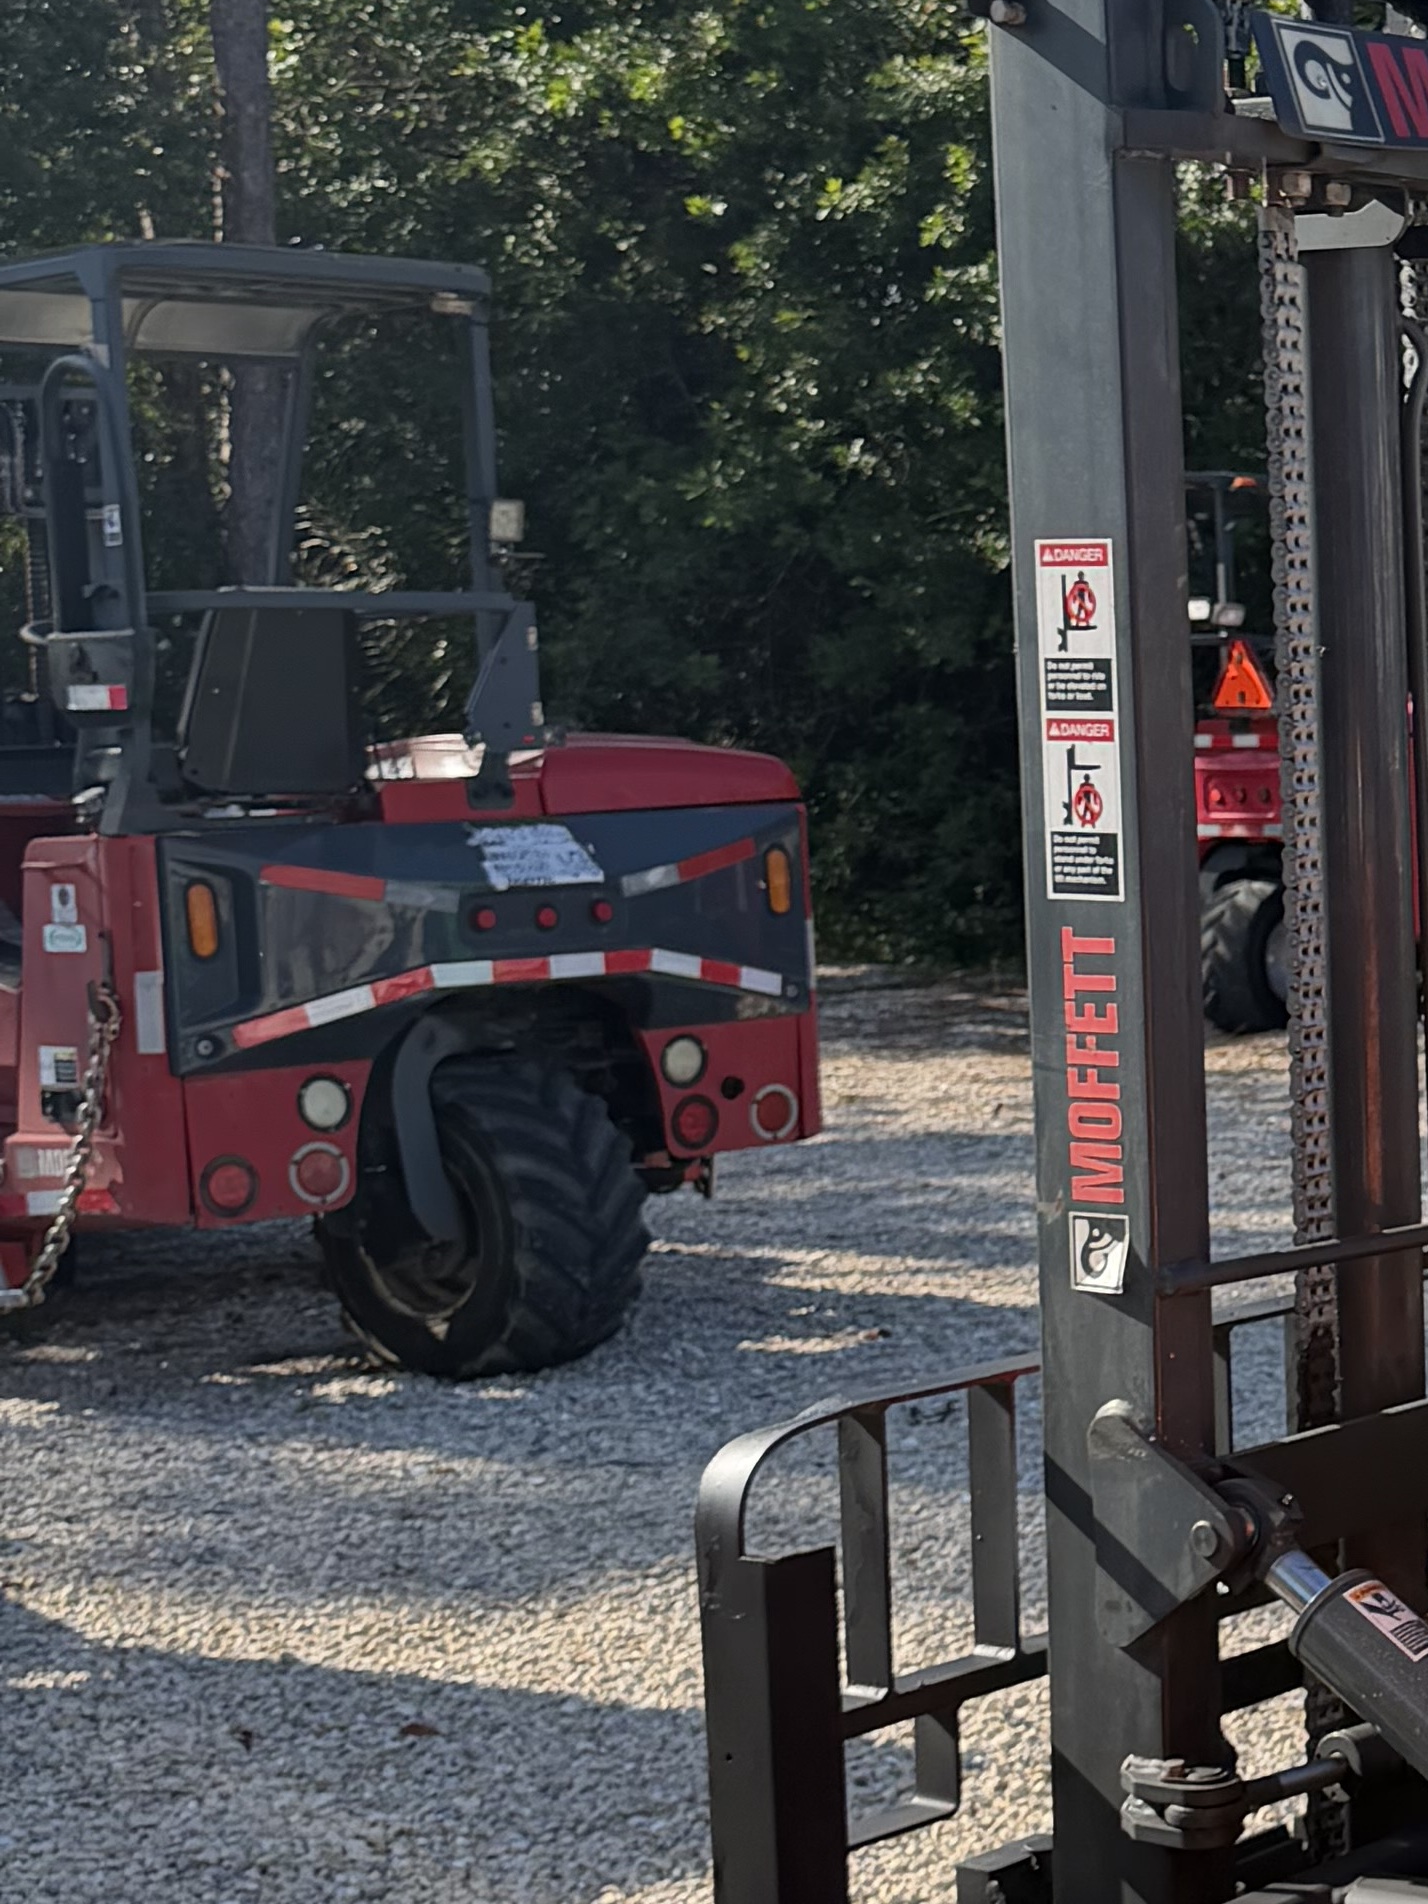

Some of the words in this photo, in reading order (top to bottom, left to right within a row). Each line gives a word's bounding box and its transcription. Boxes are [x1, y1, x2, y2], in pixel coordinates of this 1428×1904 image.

[1053, 548, 1103, 562] DANGER
[1060, 723, 1110, 737] DANGER
[1062, 927, 1124, 1204] MOFFETT
